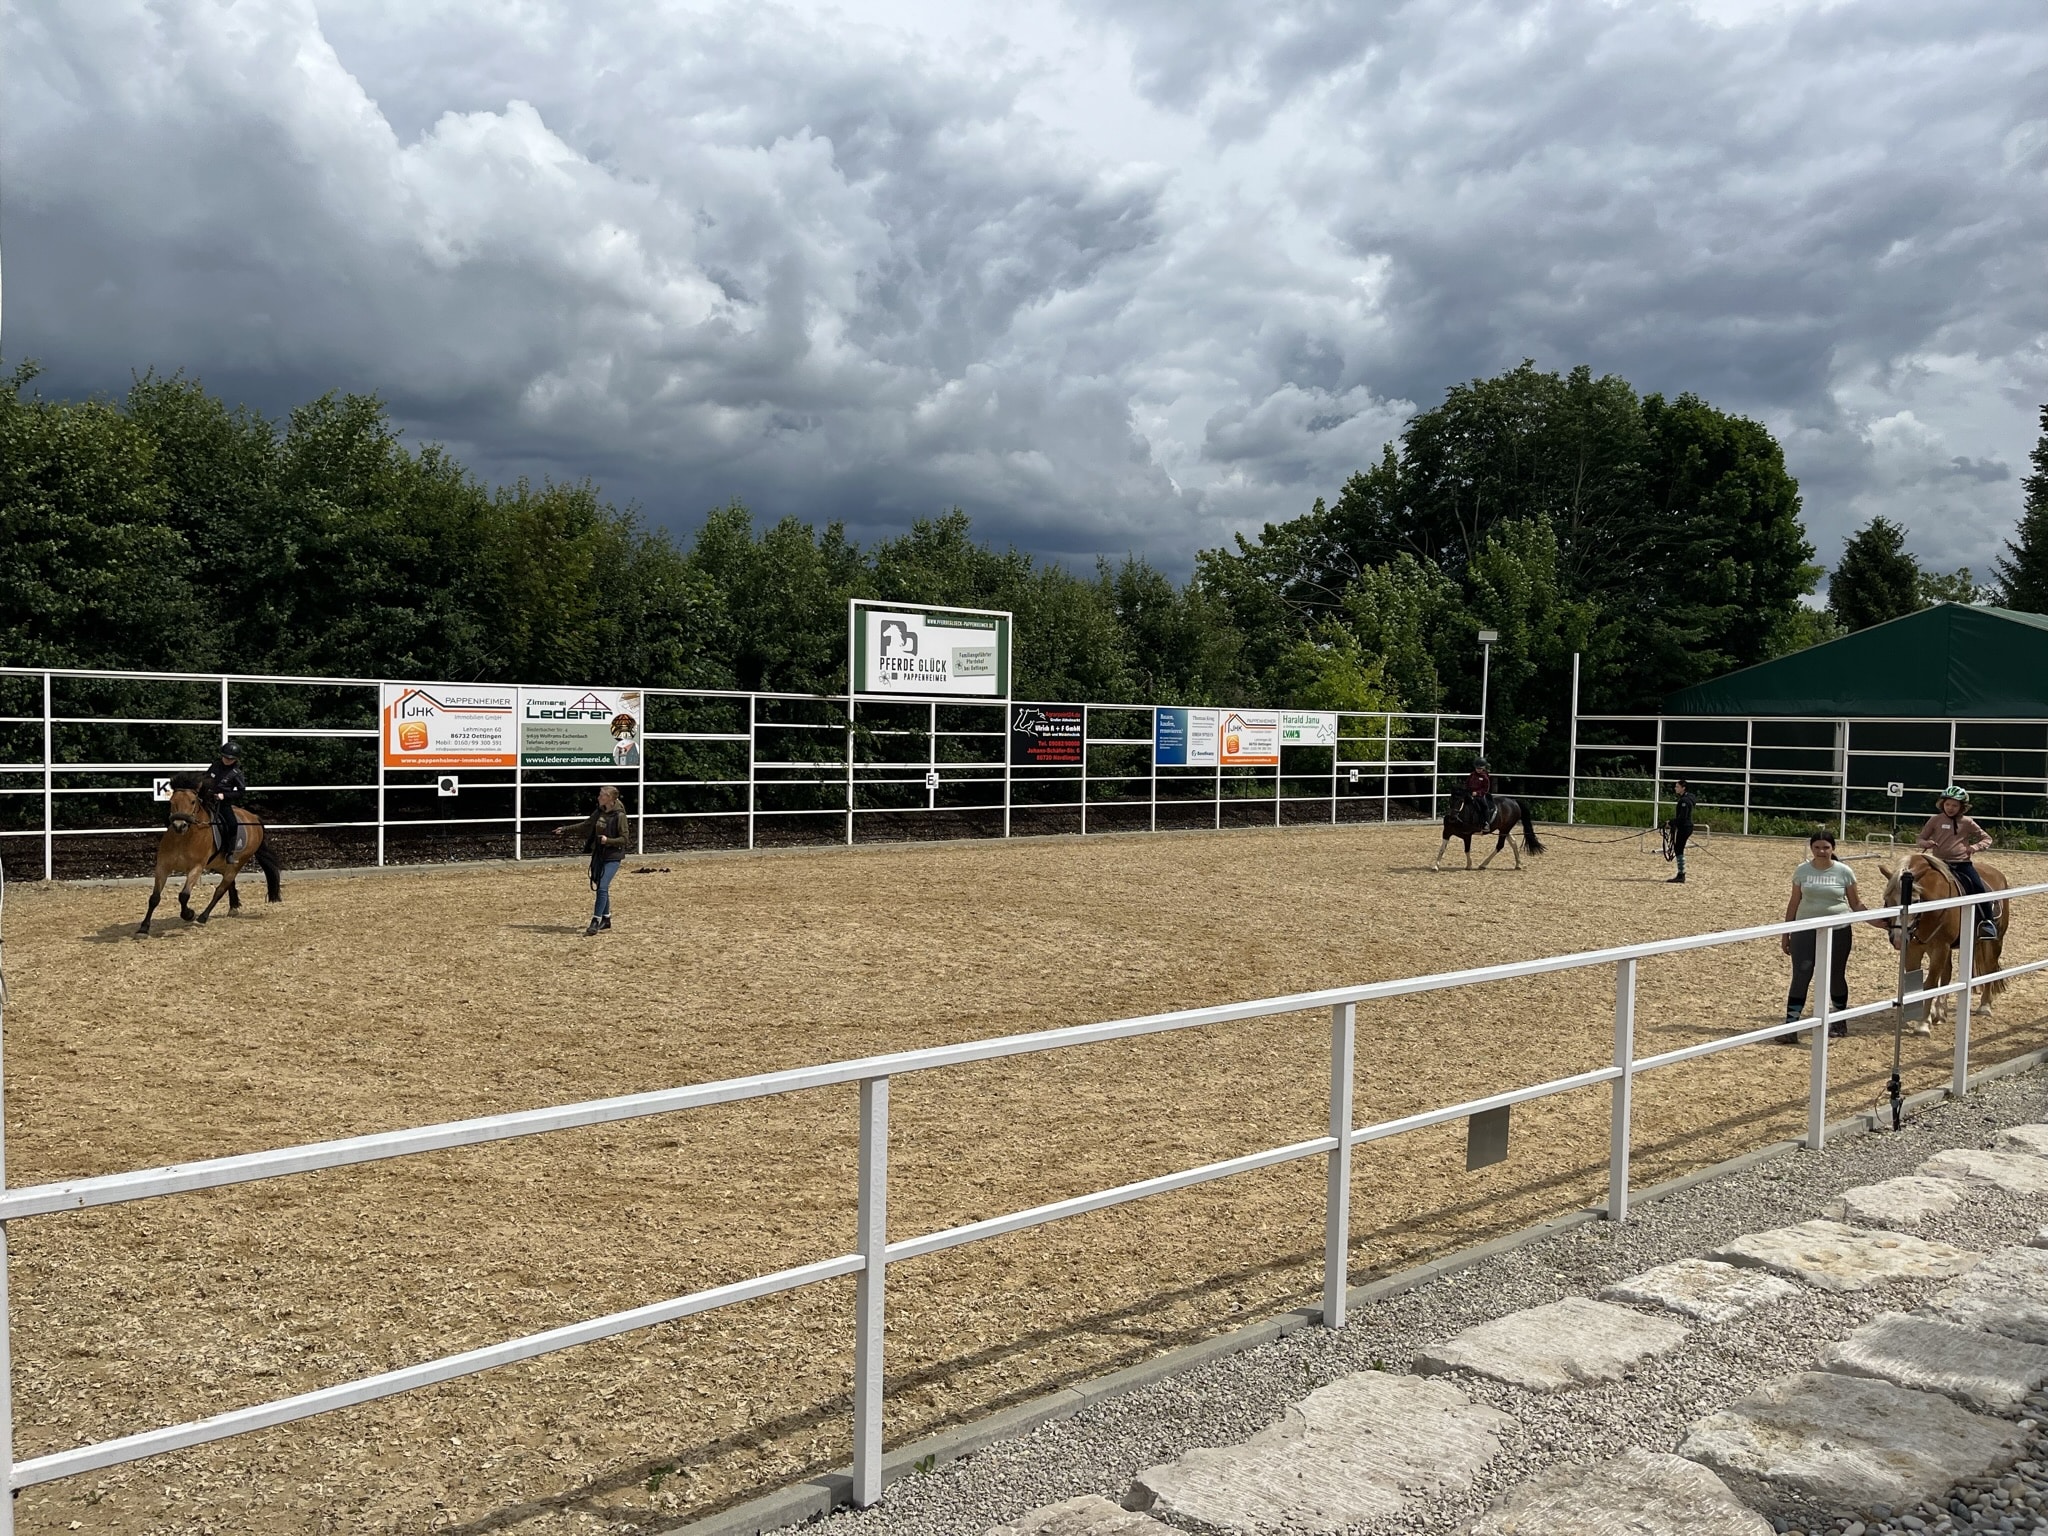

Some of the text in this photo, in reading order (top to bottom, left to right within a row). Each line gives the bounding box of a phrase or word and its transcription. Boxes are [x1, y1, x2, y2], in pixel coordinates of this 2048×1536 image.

[879, 657, 947, 673] PFERDE GLÜCK
[904, 672, 947, 682] PAPPENHEIMER
[445, 697, 511, 705] PAPPENHEIMER
[407, 707, 434, 717] JHK
[526, 707, 613, 720] Lederer
[1282, 715, 1320, 724] Harald Janu
[1282, 730, 1296, 739] LVM
[157, 781, 170, 796] K
[1890, 784, 1899, 794] C
